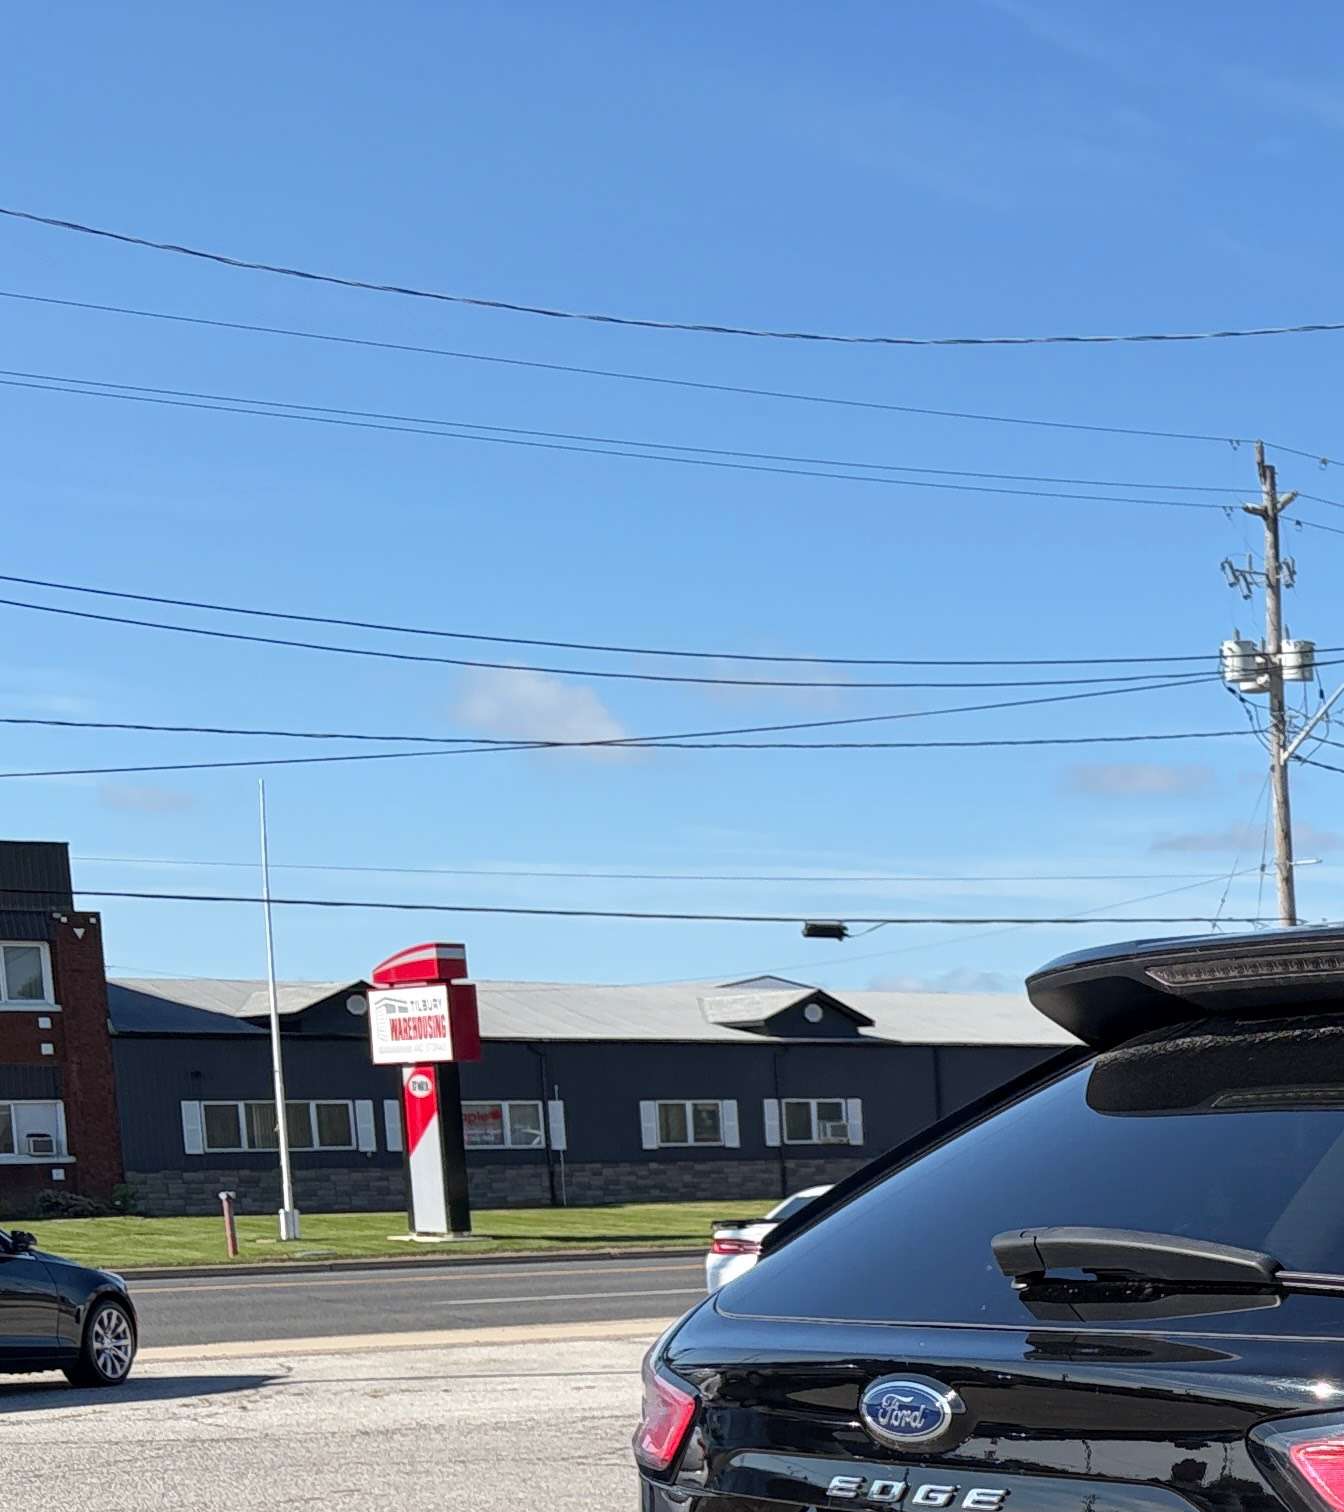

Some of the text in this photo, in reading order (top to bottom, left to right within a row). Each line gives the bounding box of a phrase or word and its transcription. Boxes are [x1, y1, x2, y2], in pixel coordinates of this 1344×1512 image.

[389, 1014, 447, 1042] WAREHOUSING
[876, 1391, 926, 1430] Ford
[826, 1474, 1011, 1512] EDGE
